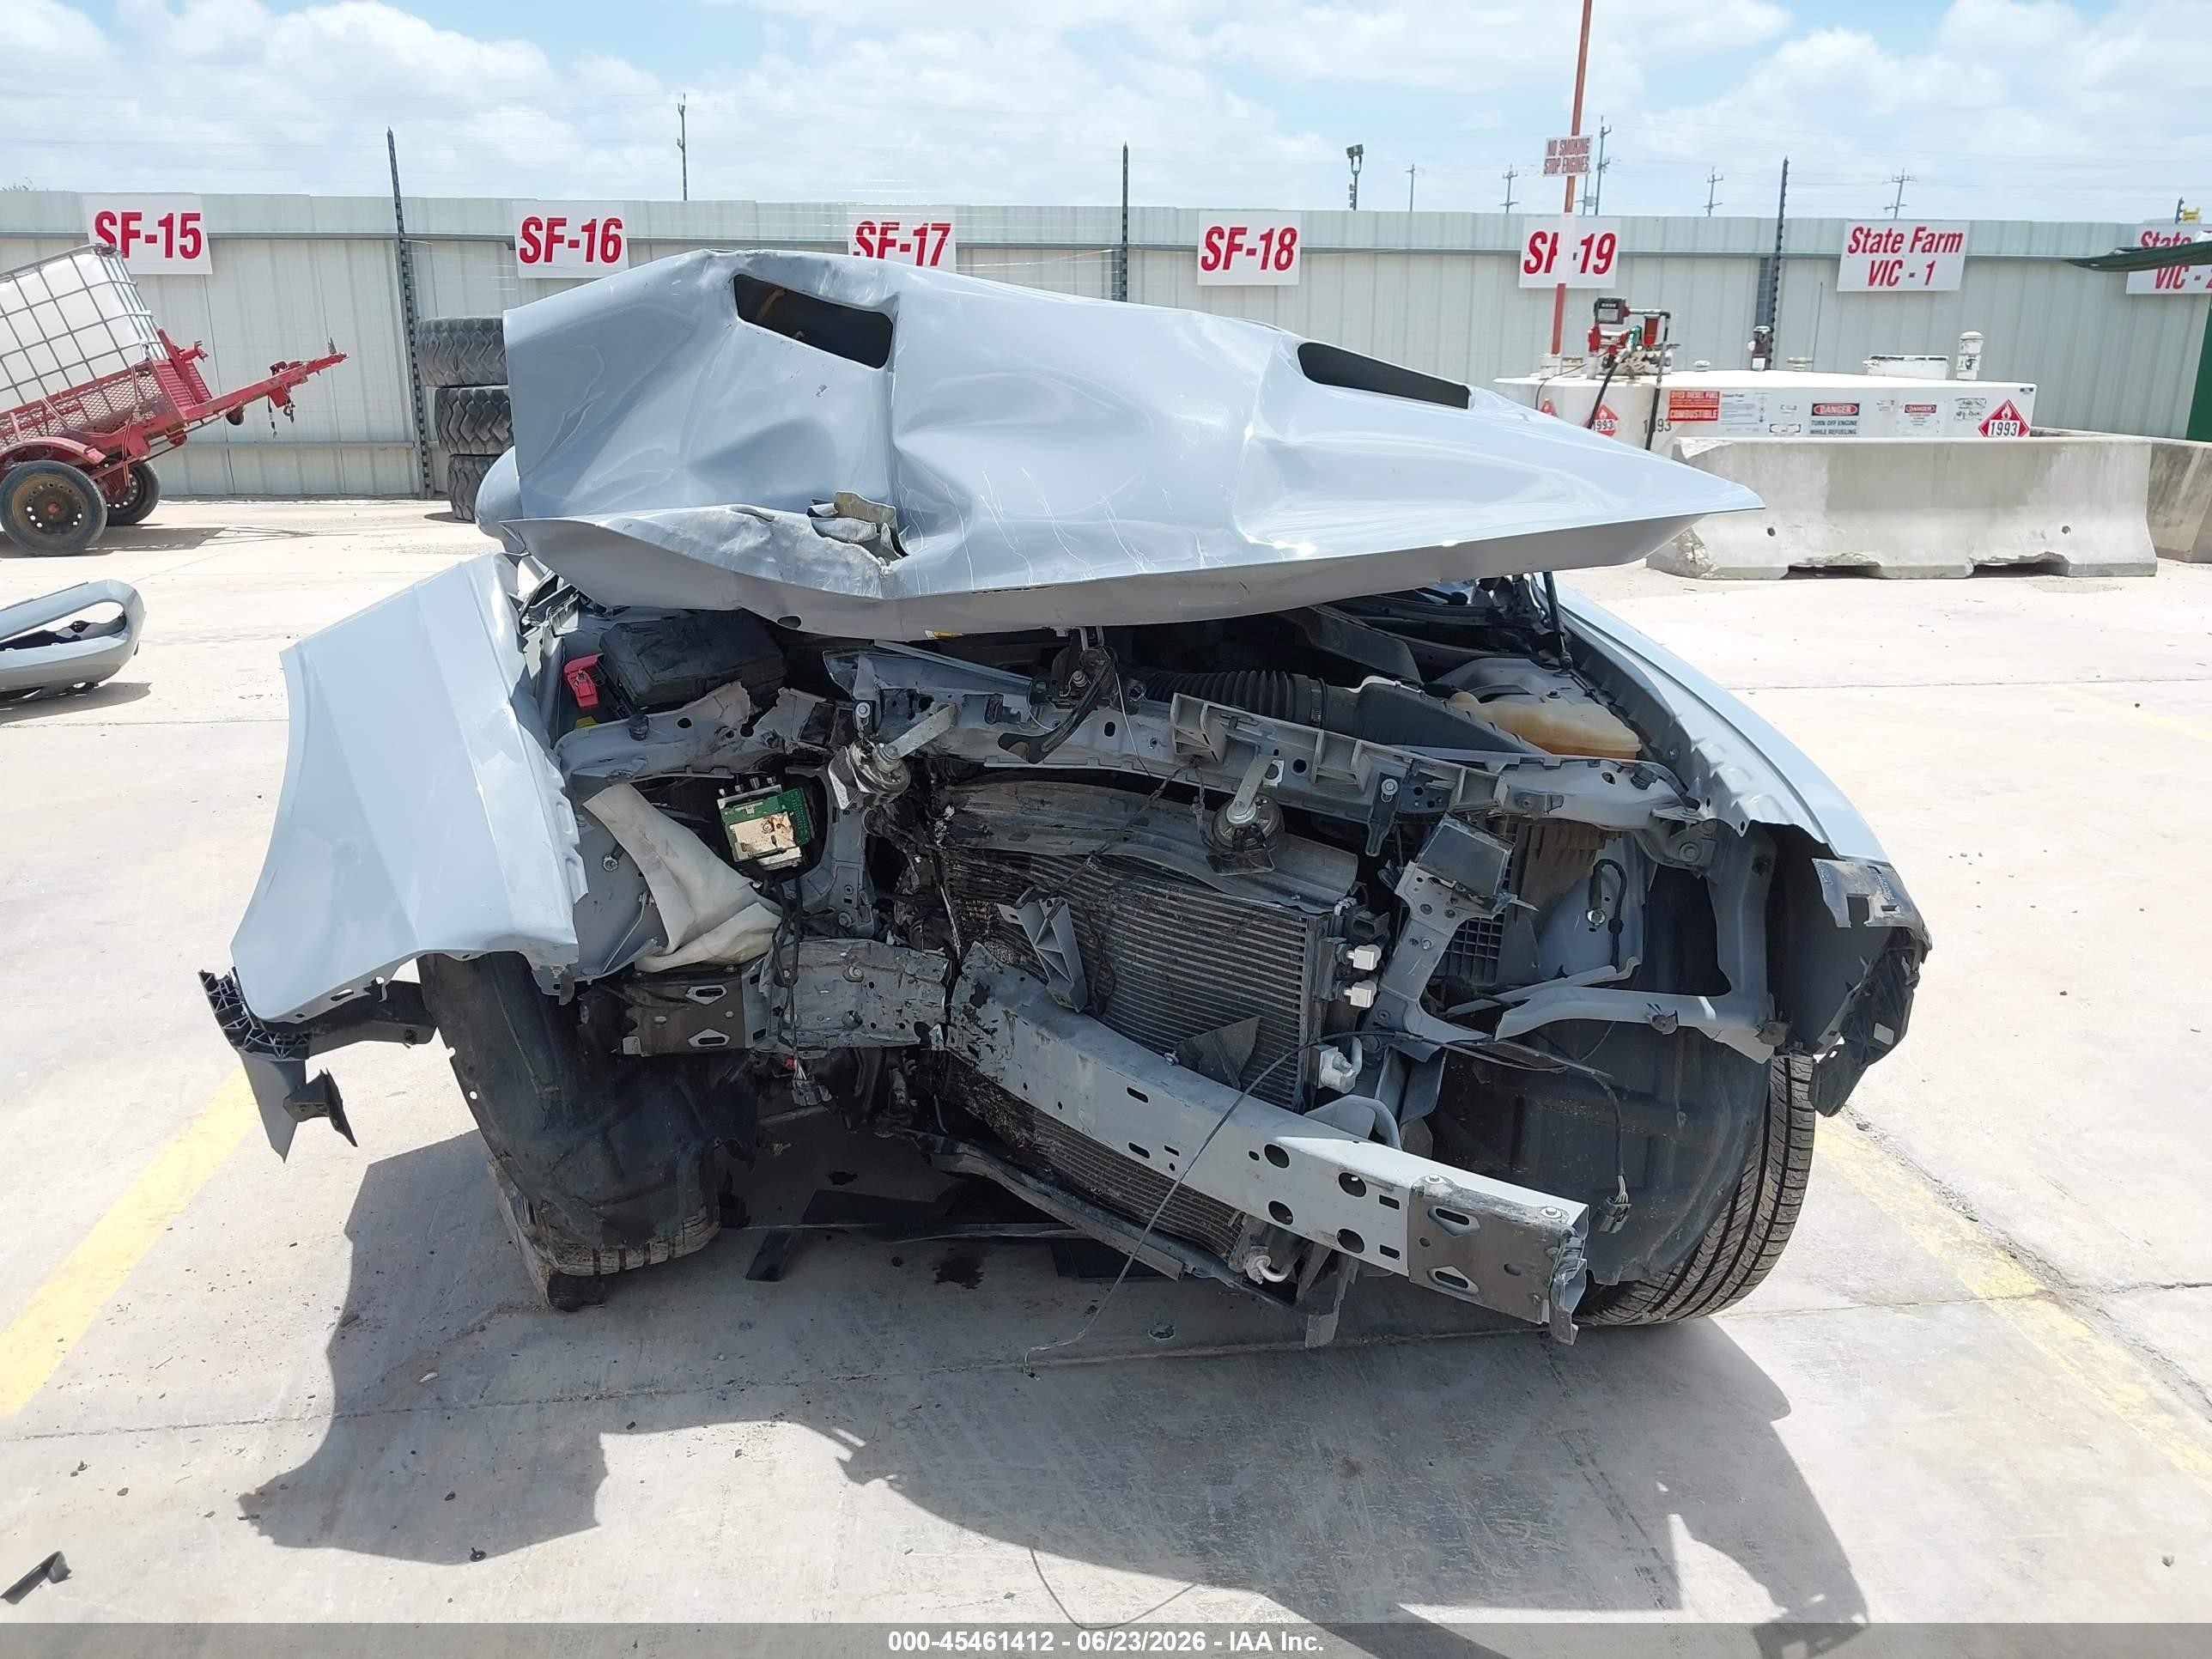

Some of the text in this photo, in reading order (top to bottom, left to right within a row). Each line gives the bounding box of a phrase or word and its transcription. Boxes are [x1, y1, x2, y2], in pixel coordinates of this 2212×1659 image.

[1544, 157, 1561, 174] STOP
[94, 210, 202, 259] SF-15
[519, 216, 623, 264] SF-16
[853, 220, 951, 267] SF-17
[1847, 226, 1964, 254] State Farm
[1200, 226, 1297, 271] SF-18
[1868, 259, 1904, 287] VIC
[1924, 260, 1936, 286] 1
[2155, 264, 2190, 289] VIC
[1669, 409, 1717, 419] COMBUSTIBLE
[1820, 404, 1851, 414] DANGER
[1594, 420, 1613, 430] 993
[1643, 418, 1671, 434] 193
[1990, 421, 2018, 436] 1993
